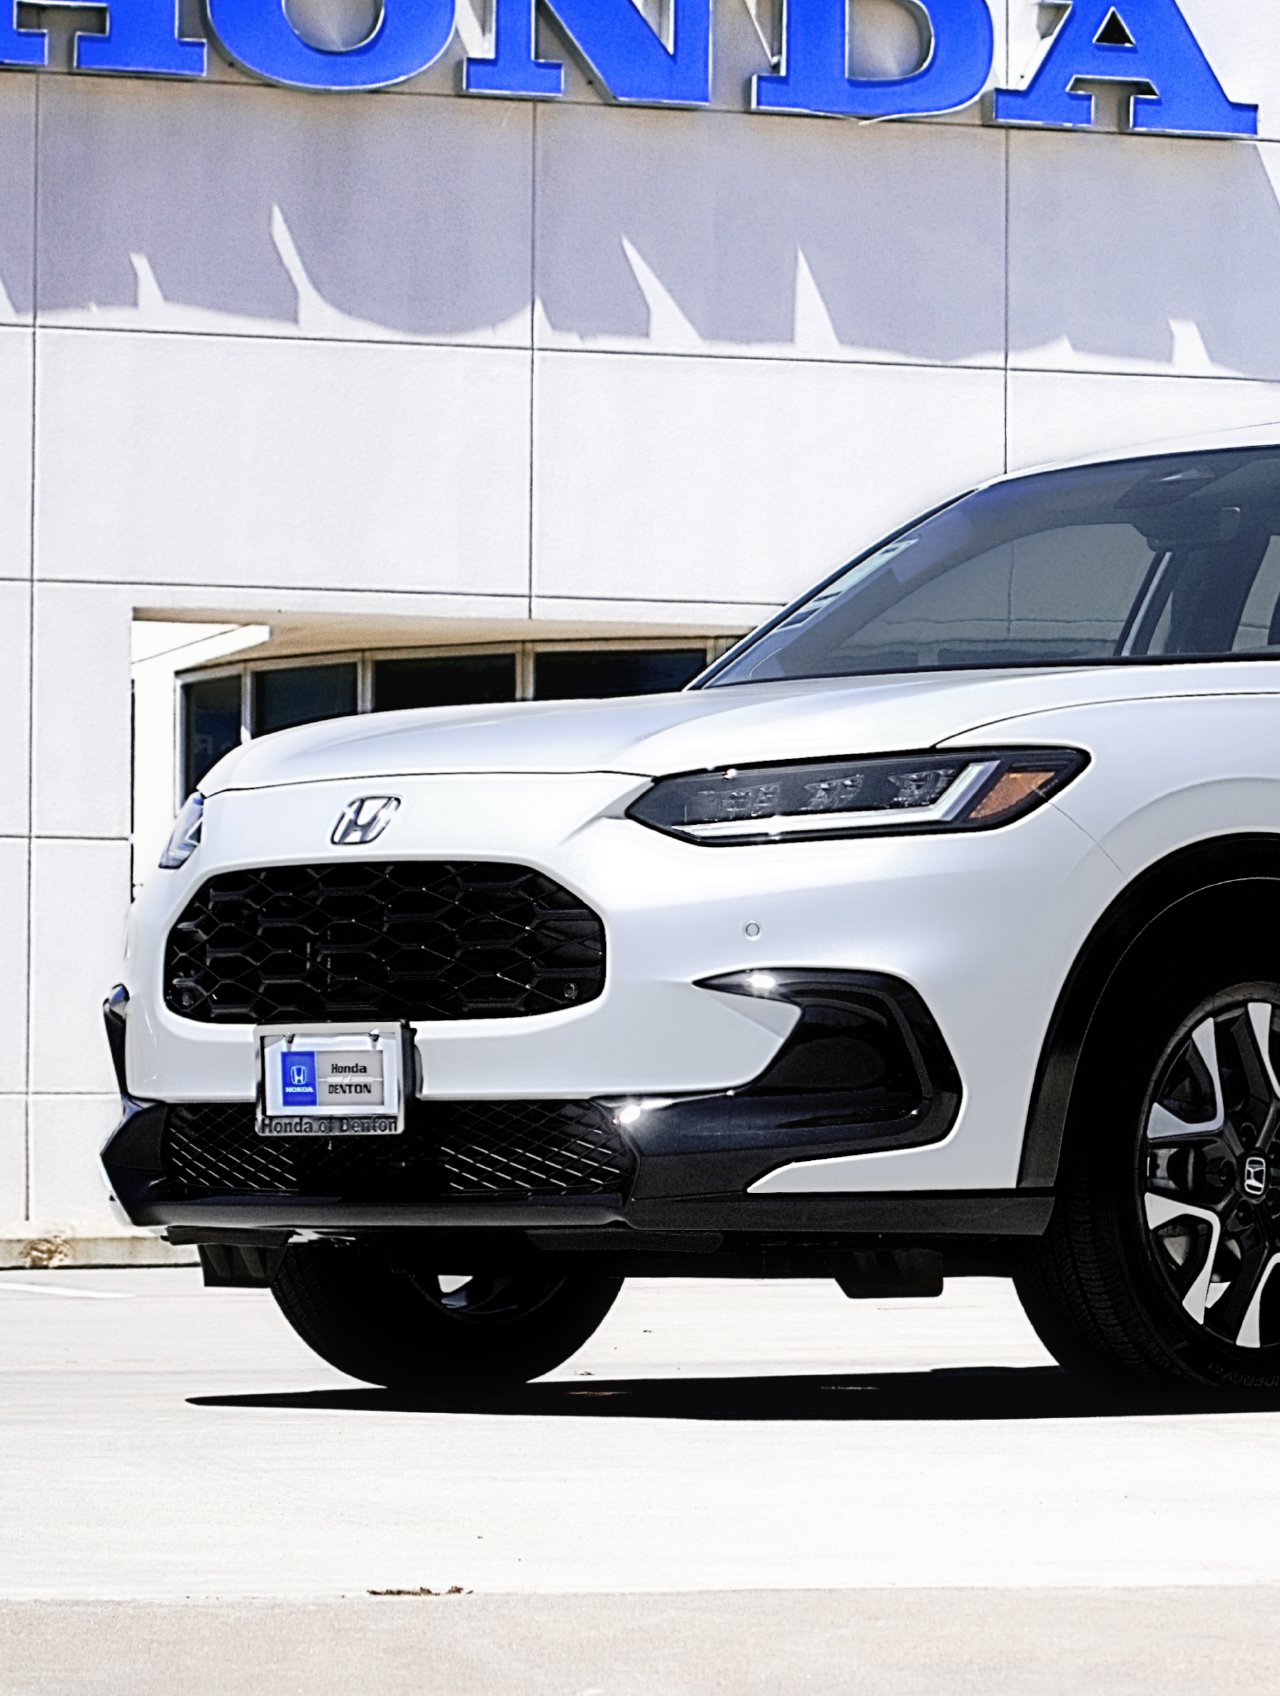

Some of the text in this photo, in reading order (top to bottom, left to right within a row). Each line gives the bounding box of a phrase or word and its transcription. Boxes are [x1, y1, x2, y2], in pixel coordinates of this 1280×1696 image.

[331, 1063, 367, 1073] Honda
[328, 1083, 372, 1094] DENTON
[261, 1116, 398, 1134] Honda of Denton
